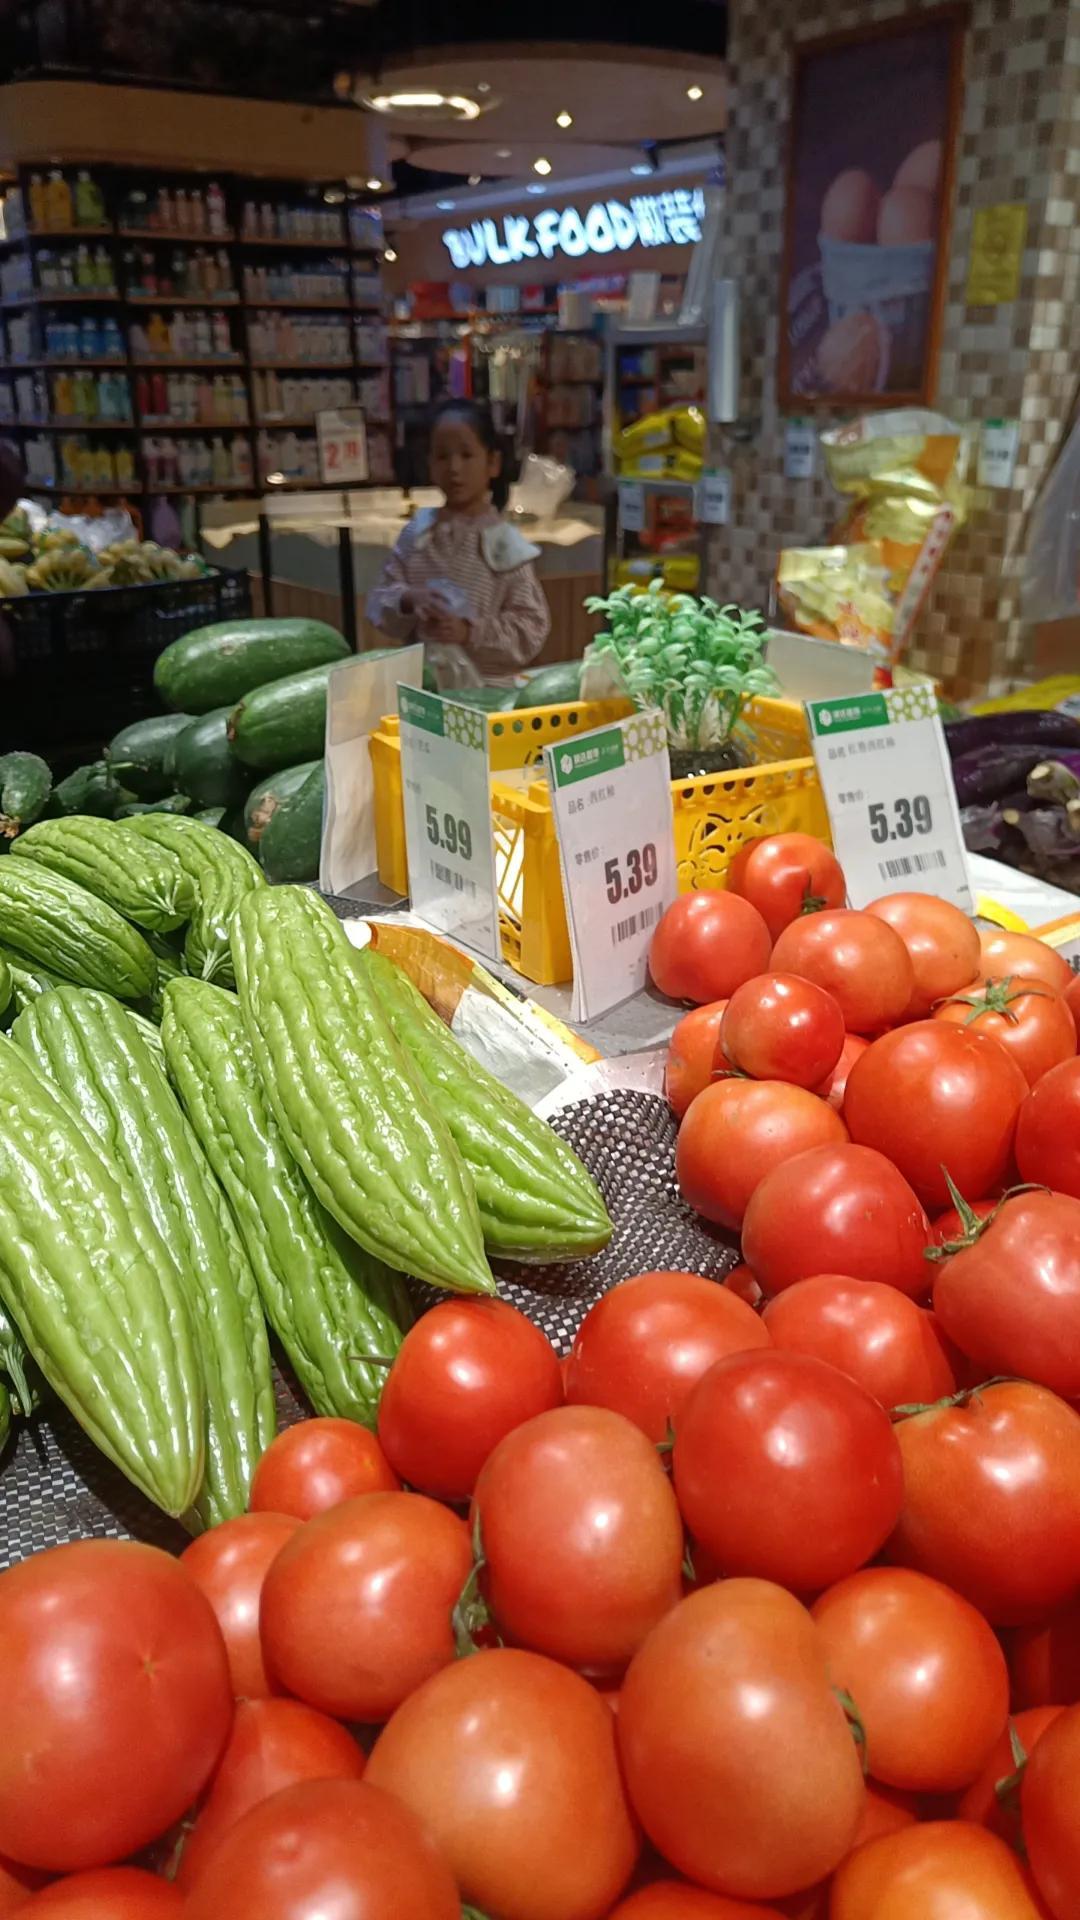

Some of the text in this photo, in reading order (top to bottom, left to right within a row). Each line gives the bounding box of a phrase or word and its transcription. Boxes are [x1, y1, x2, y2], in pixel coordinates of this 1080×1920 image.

[425, 804, 473, 861] 5.99
[868, 795, 932, 844] 5.39
[604, 843, 658, 905] 5.39
